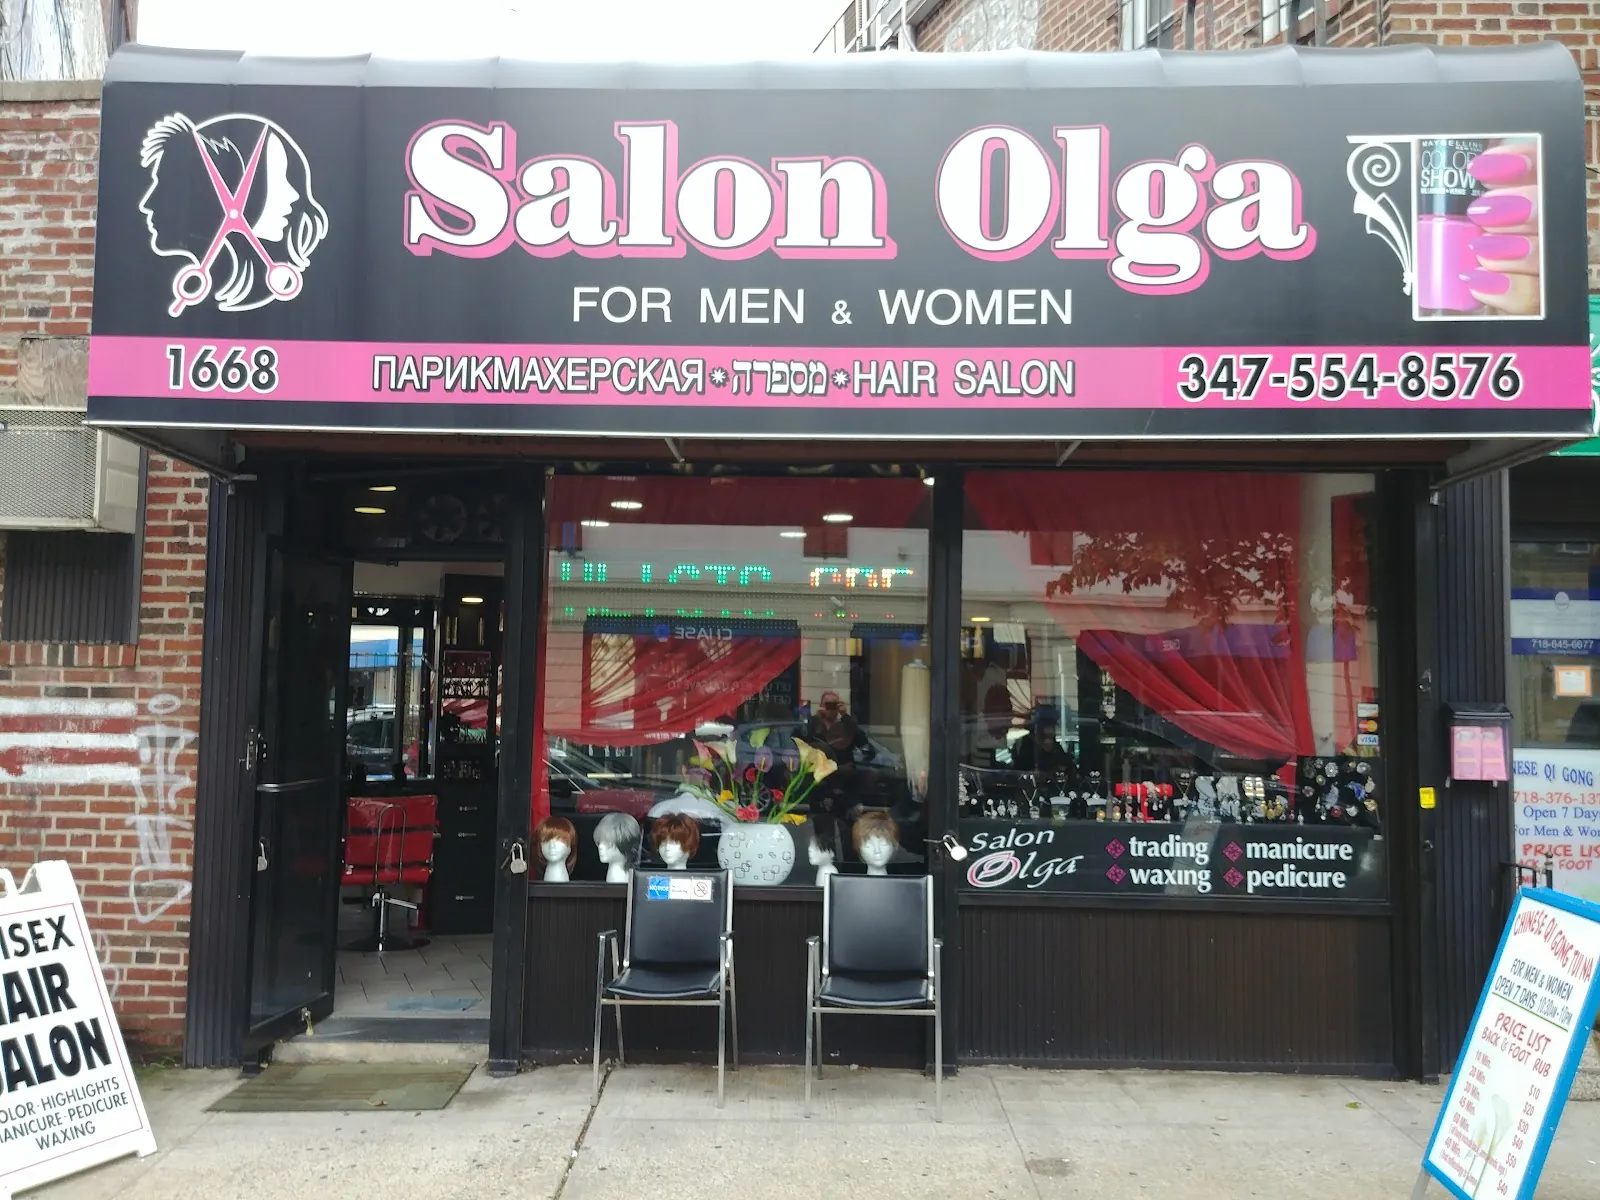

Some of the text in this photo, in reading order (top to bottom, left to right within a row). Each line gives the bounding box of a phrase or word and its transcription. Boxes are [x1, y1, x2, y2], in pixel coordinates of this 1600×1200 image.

[1420, 168, 1476, 189] SHOW
[404, 119, 1317, 295] Salon Olga
[573, 287, 1073, 326] FOR MEN & WOMEN
[166, 344, 279, 394] 1668
[372, 354, 706, 396] ПАРИКМАХЕРСКАЯ
[731, 359, 830, 397] מספרה
[852, 358, 1076, 398] HAIR SALON
[1177, 352, 1523, 402] 347-554-8576
[1359, 736, 1377, 744] VISA
[1544, 764, 1556, 782] QI
[1562, 766, 1593, 787] GONG
[1523, 805, 1557, 820] Open
[1561, 806, 1569, 818] 7
[969, 827, 1055, 853] Salon
[1534, 825, 1559, 837] Men
[1562, 825, 1573, 837] &
[1129, 834, 1209, 865] trading
[1246, 837, 1353, 861] manicure
[1130, 865, 1212, 893] waxing
[1246, 863, 1347, 893] pedicure
[1558, 859, 1592, 871] FOOT
[1513, 910, 1548, 936] CHINESE
[1550, 930, 1574, 968] GONG
[0, 962, 78, 1026] AIR
[1494, 975, 1513, 997] OPEN
[1512, 985, 1521, 999] 7
[1519, 987, 1538, 1009] DAYS
[1510, 958, 1526, 978] FOR
[1524, 965, 1541, 984] MEN
[1545, 974, 1574, 1001] WOMEN
[1494, 1013, 1551, 1055] PRICE LIST
[0, 1017, 112, 1096] ALON
[1481, 1026, 1500, 1047] BACK
[1507, 1042, 1531, 1065] FOOT
[1533, 1058, 1552, 1077] RUB
[41, 1076, 120, 1112] HIGHLIGHTS
[68, 1092, 129, 1123] PEDICURE
[1528, 1084, 1541, 1100] $10
[1522, 1101, 1535, 1116] $20
[35, 1121, 96, 1151] WAXING
[1517, 1118, 1529, 1135] $30
